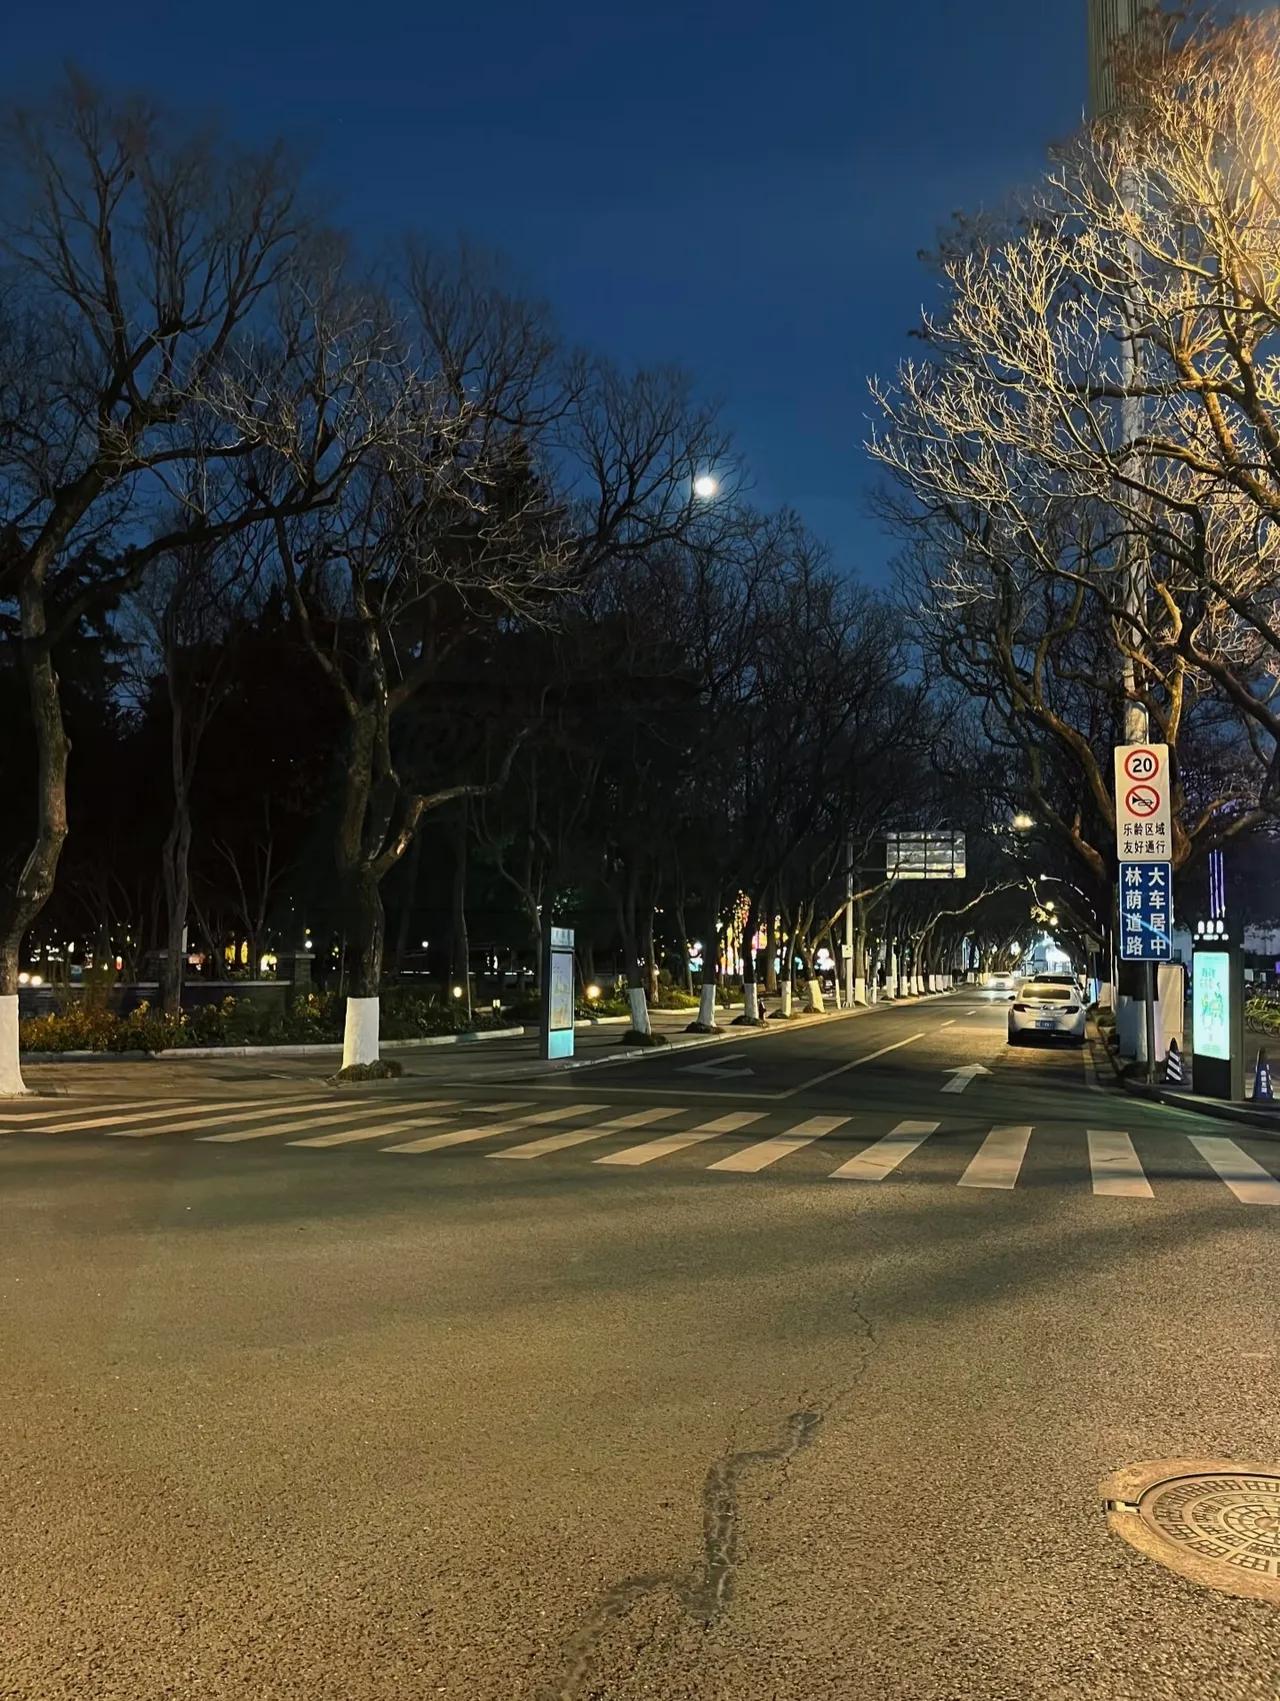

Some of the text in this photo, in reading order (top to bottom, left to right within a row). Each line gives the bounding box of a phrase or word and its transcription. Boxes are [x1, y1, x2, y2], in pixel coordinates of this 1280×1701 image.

[1133, 758, 1153, 773] 20
[1123, 823, 1165, 836] 乐龄区域
[1123, 840, 1165, 854] 友好通行
[1125, 867, 1143, 956] 林荫道路
[1148, 867, 1167, 956] 大车居中
